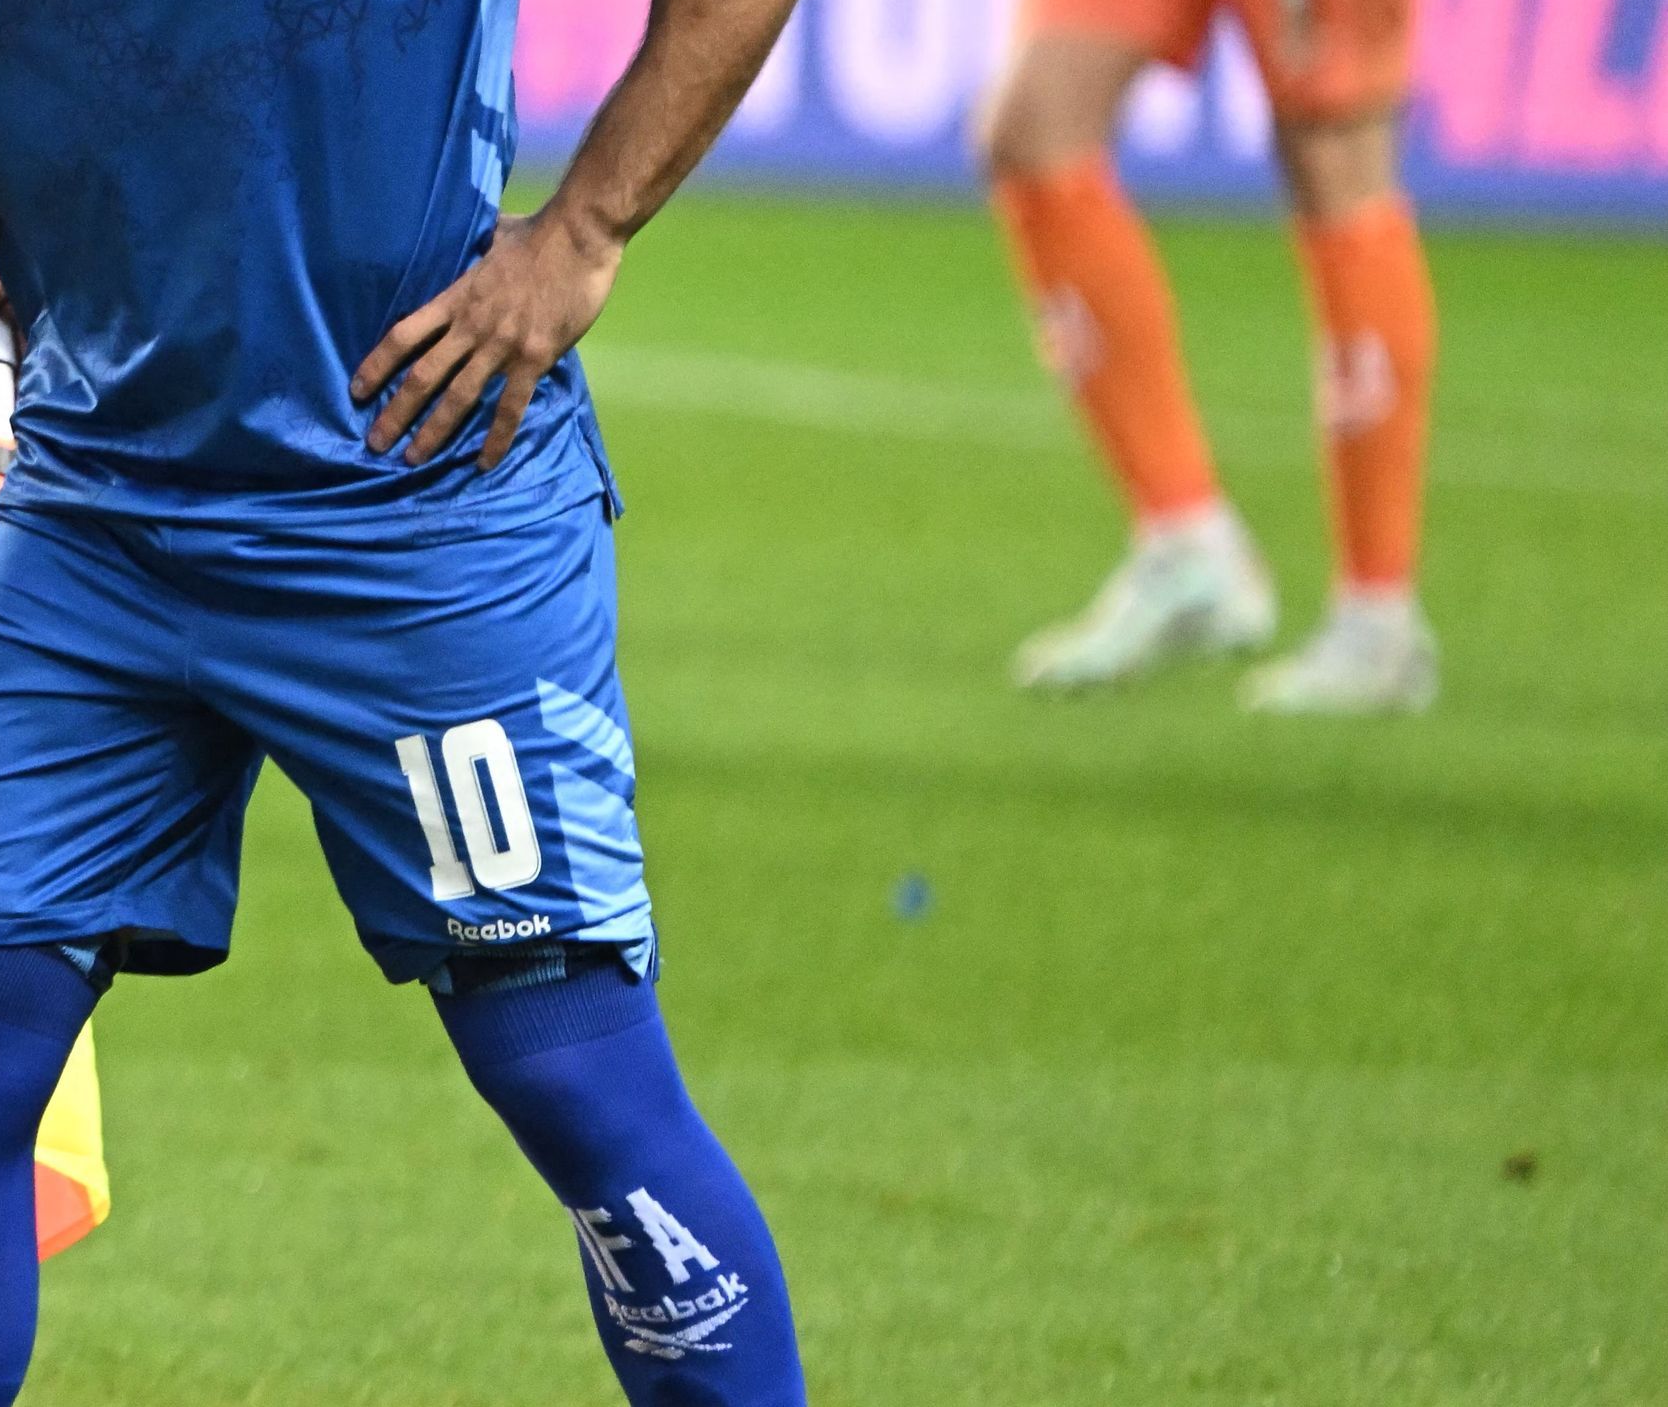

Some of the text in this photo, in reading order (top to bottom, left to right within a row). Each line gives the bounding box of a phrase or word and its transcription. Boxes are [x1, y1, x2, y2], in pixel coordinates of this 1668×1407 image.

[394, 718, 542, 901] 10
[447, 914, 552, 941] Reebok
[604, 1272, 749, 1326] Reebok
